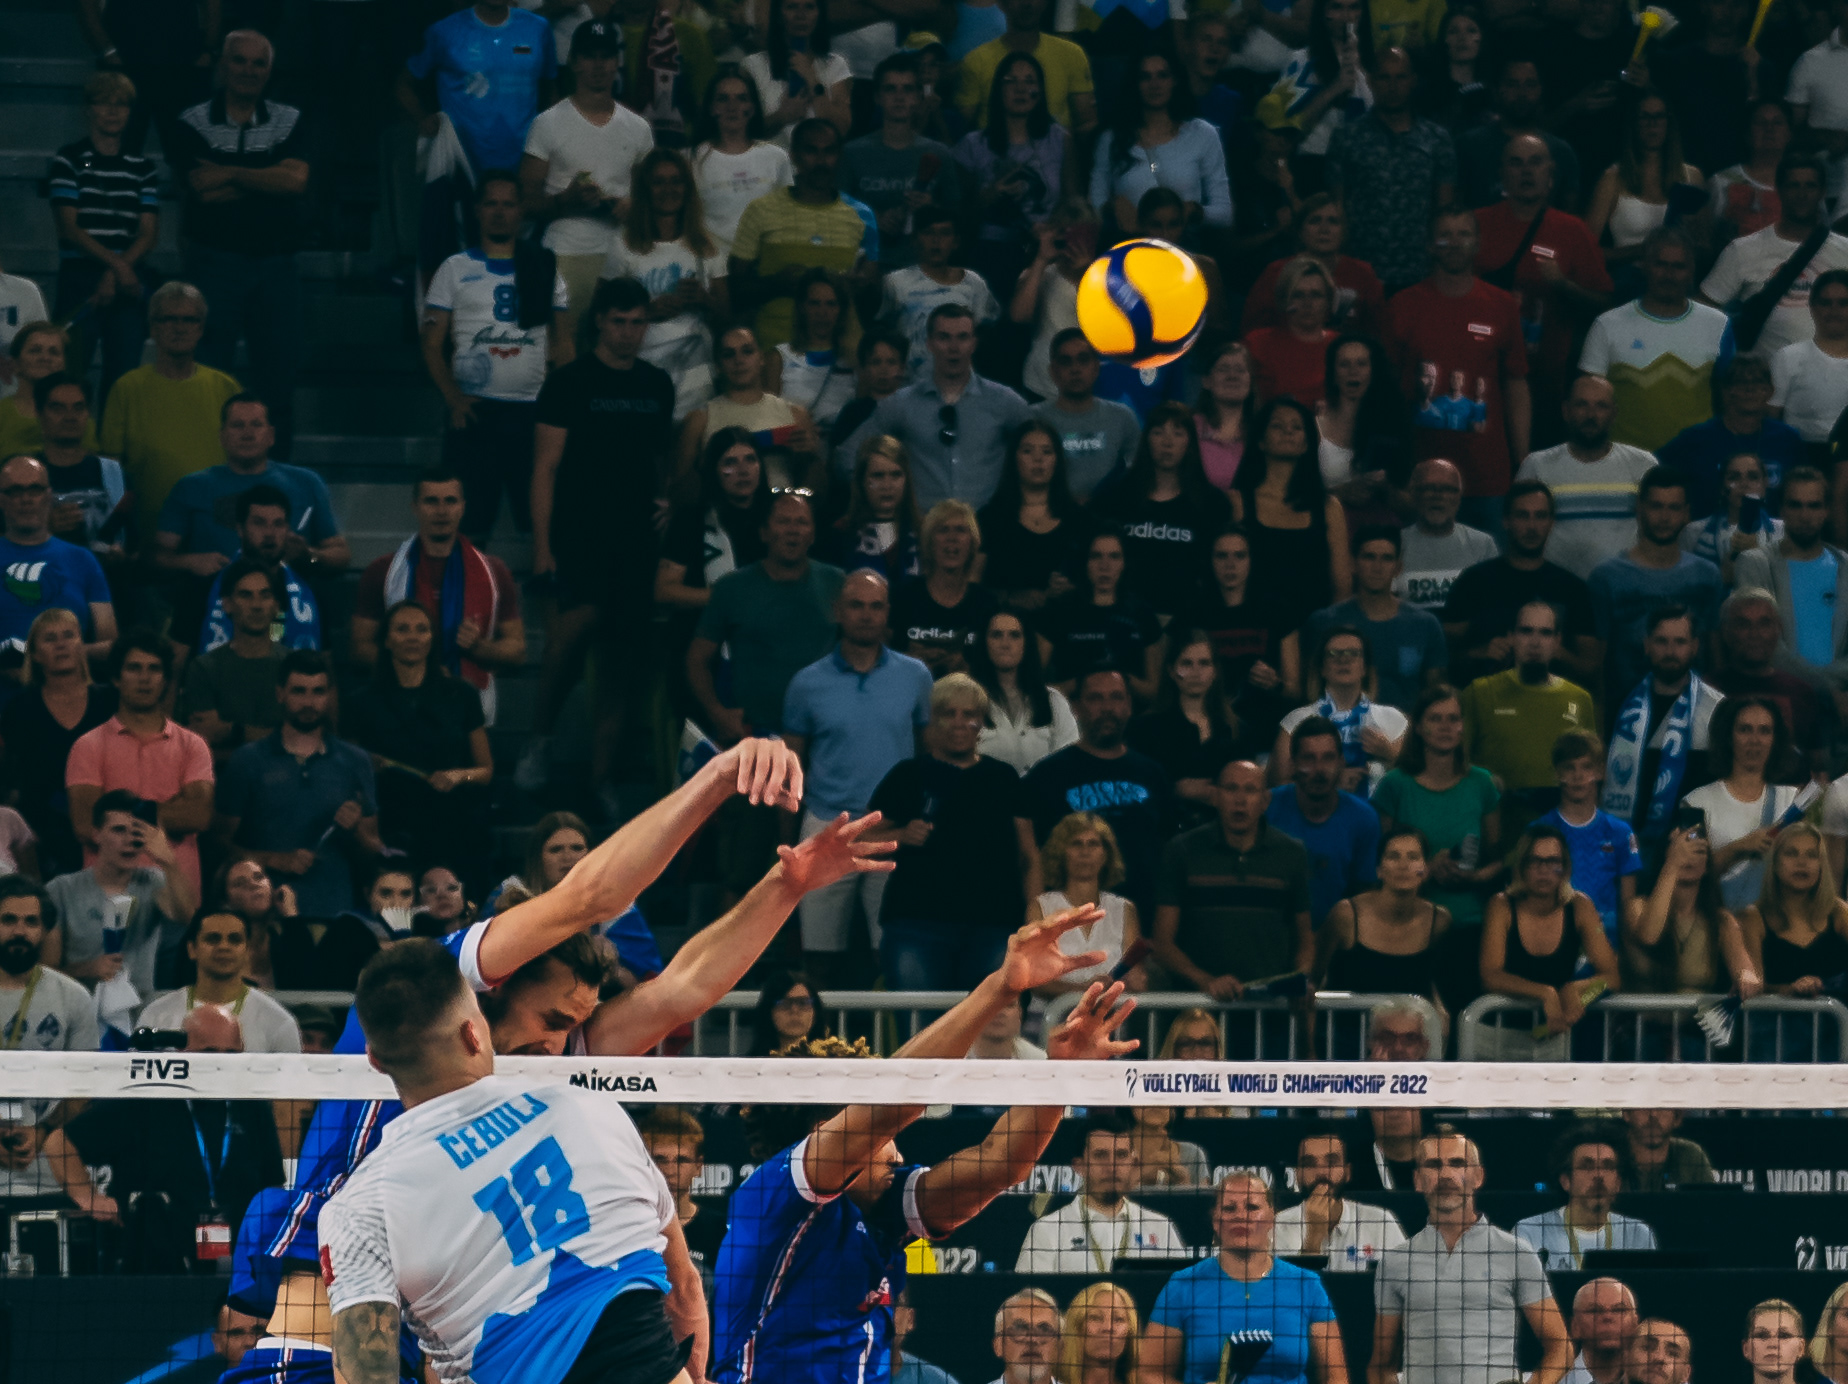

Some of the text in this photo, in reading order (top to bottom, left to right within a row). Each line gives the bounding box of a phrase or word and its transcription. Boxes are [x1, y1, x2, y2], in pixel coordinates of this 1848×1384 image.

[1141, 1073, 1428, 1094] VOLLEYBALL WORLD CHAMPIONSHIP 2022
[472, 1134, 591, 1267] 18
